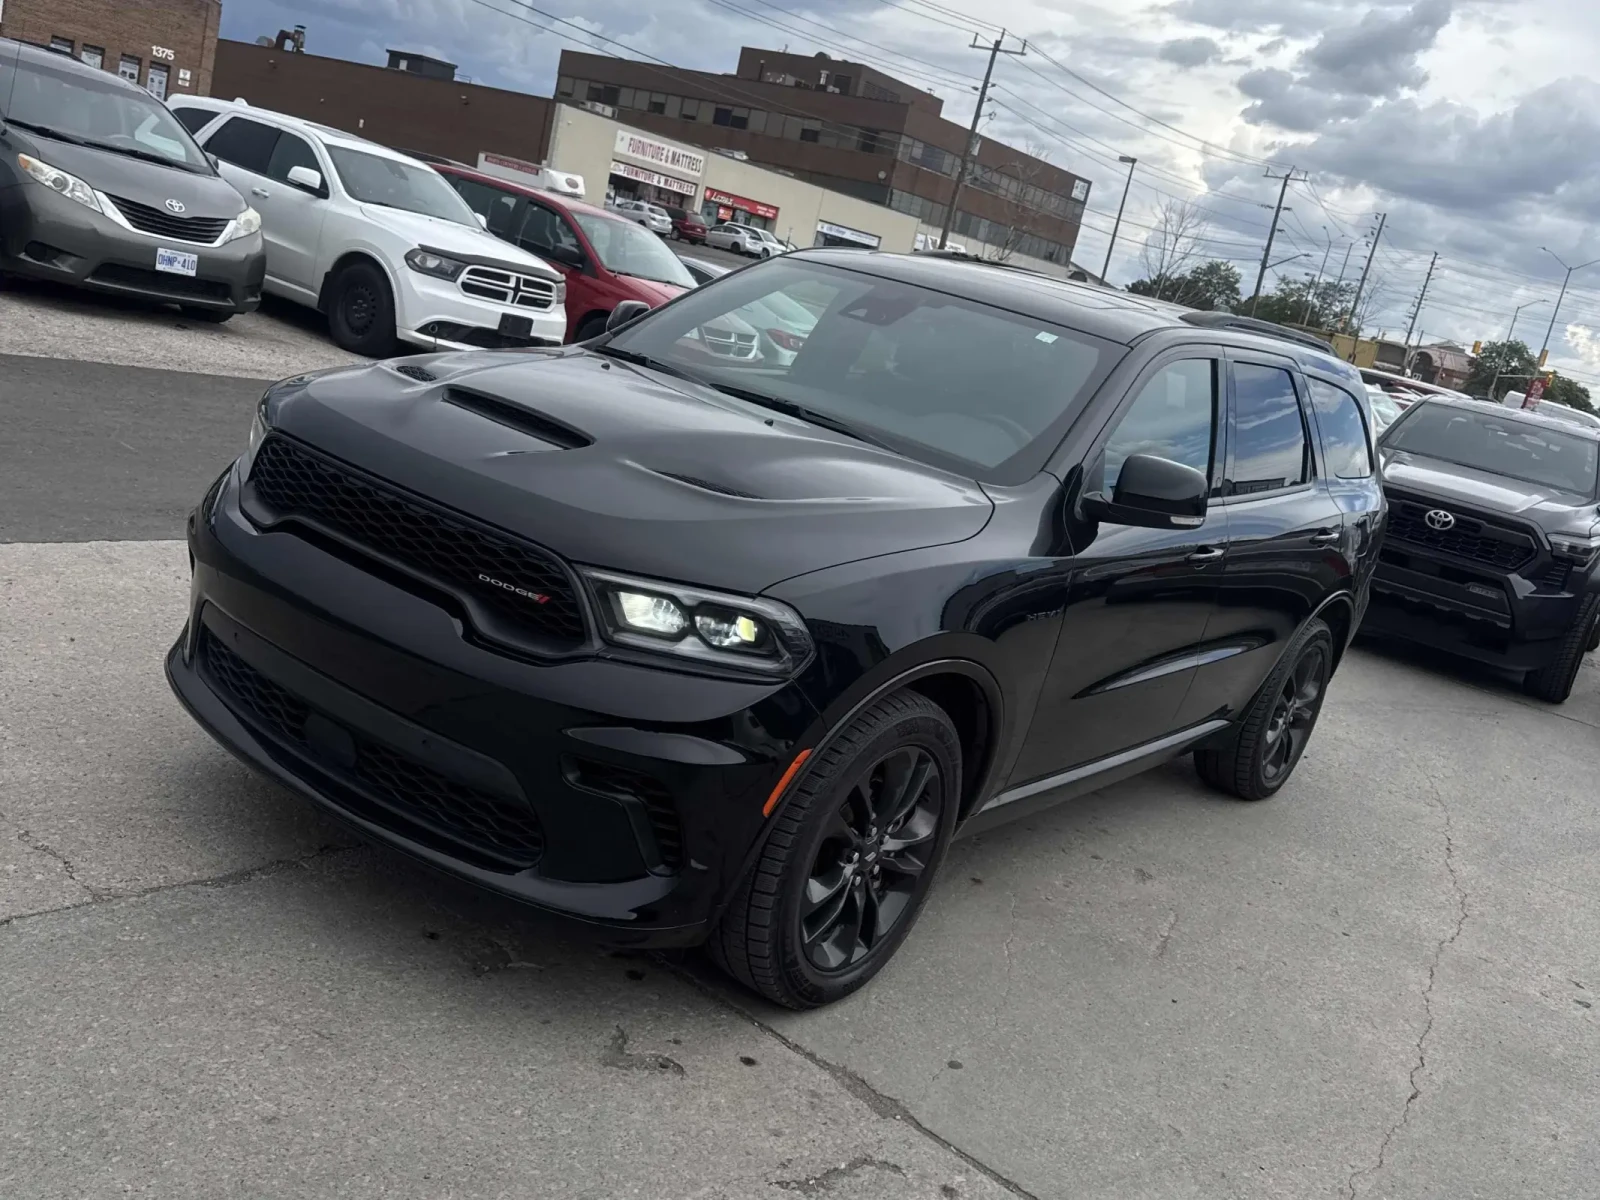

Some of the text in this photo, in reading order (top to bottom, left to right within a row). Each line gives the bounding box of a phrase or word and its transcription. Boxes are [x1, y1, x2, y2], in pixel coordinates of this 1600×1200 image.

[151, 44, 175, 61] 1375
[627, 137, 703, 173] FURNITURE & MATTRESS
[622, 165, 694, 195] FURNITURE & MATTRESS
[478, 573, 540, 601] DODGE
